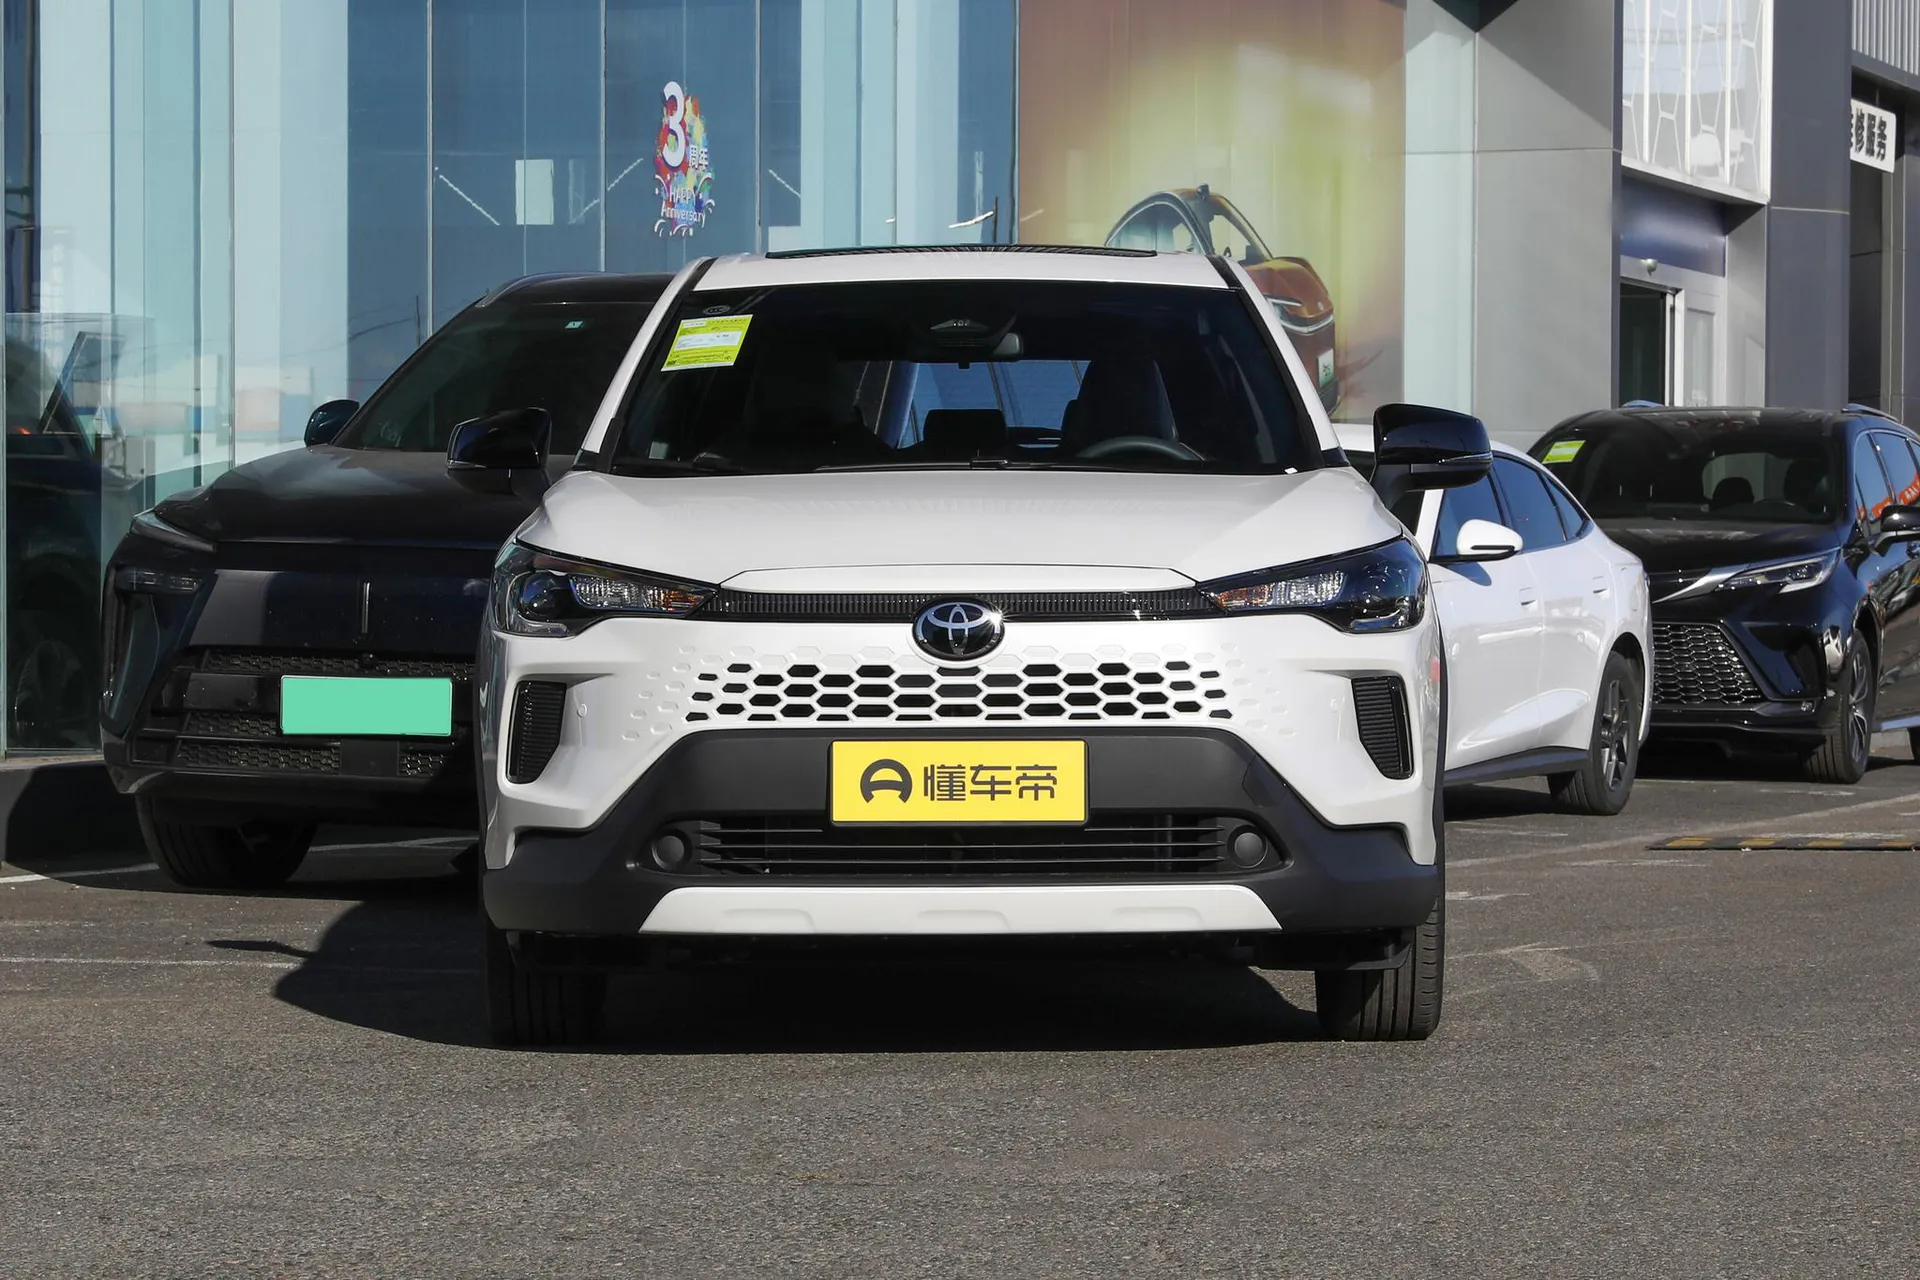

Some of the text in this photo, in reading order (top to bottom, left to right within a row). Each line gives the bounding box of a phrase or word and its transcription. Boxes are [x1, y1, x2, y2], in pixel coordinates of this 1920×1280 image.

[662, 81, 686, 168] 3
[669, 185, 697, 206] HAPPY
[660, 200, 706, 228] Anniversary
[923, 764, 1057, 801] 懂车帝
